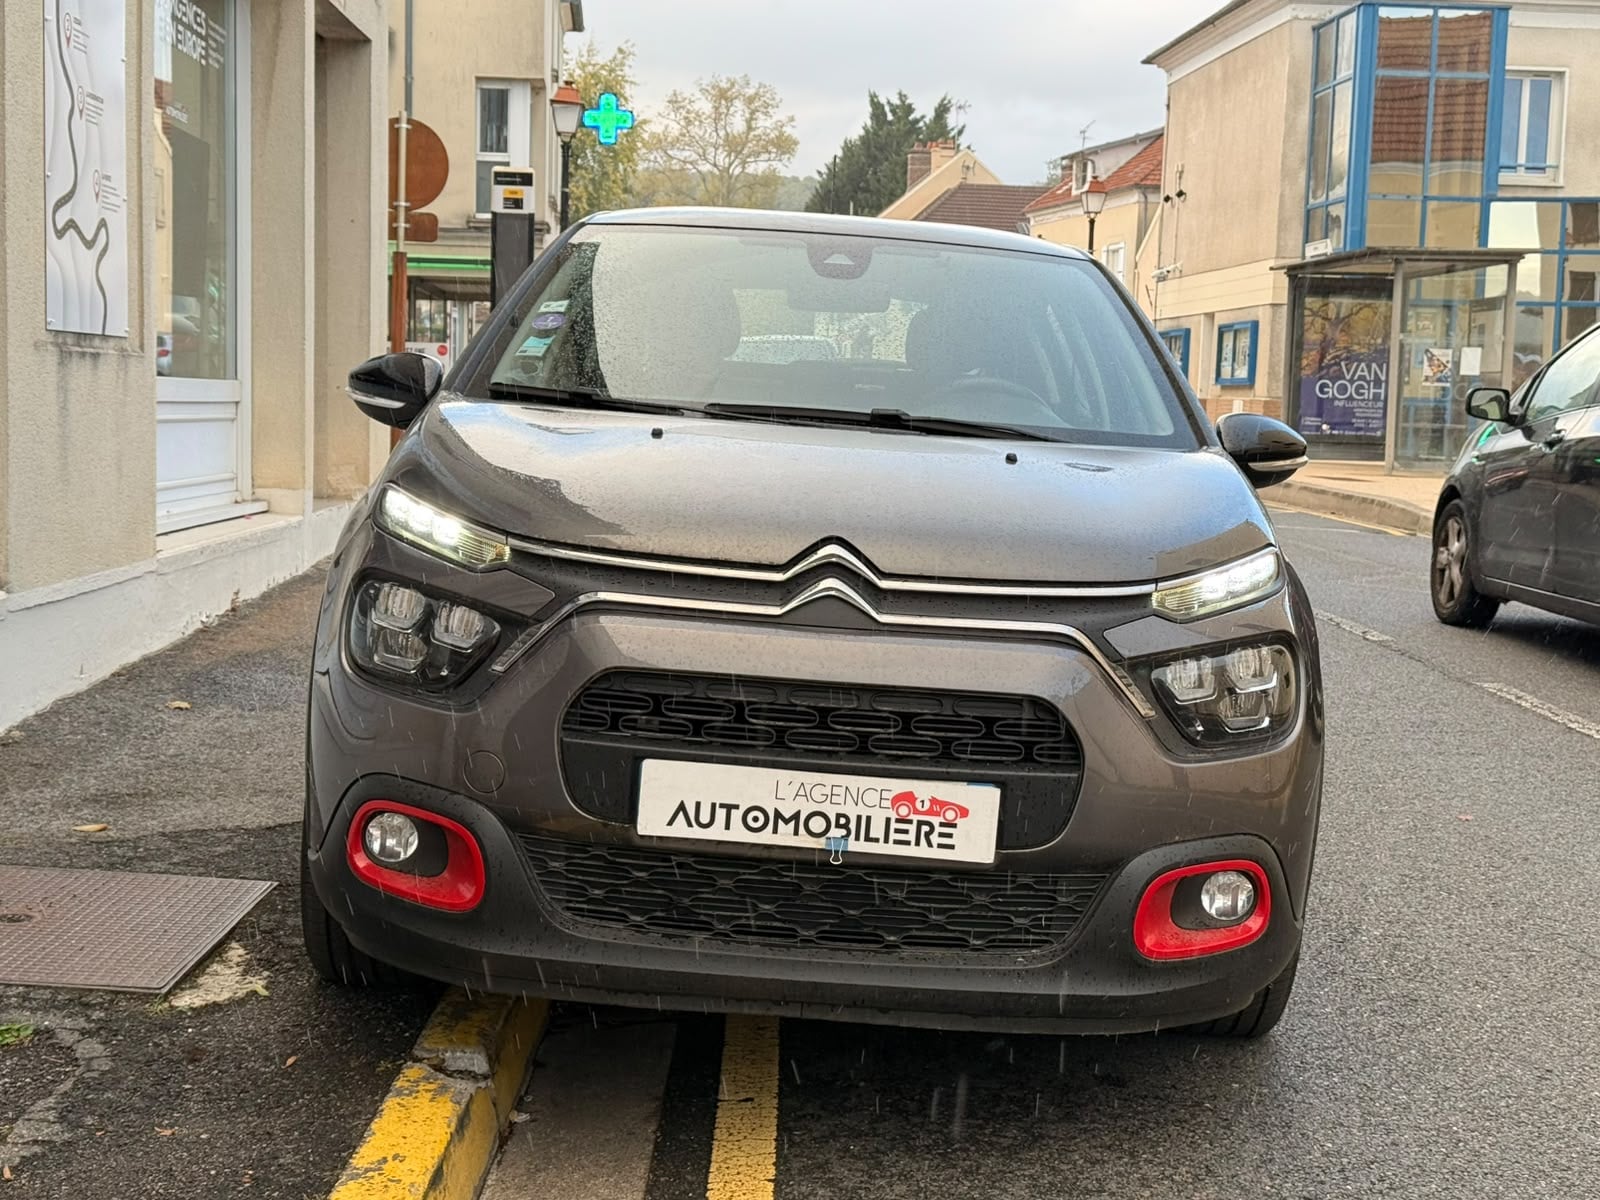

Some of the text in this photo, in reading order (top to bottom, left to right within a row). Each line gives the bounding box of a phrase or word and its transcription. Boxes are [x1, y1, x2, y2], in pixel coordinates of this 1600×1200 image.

[176, 22, 206, 66] EUROPE
[1341, 361, 1387, 381] VAN
[1315, 379, 1386, 400] GOGH
[1333, 399, 1384, 408] INFLUENCEUR
[774, 779, 925, 810] L'AGENCE 1
